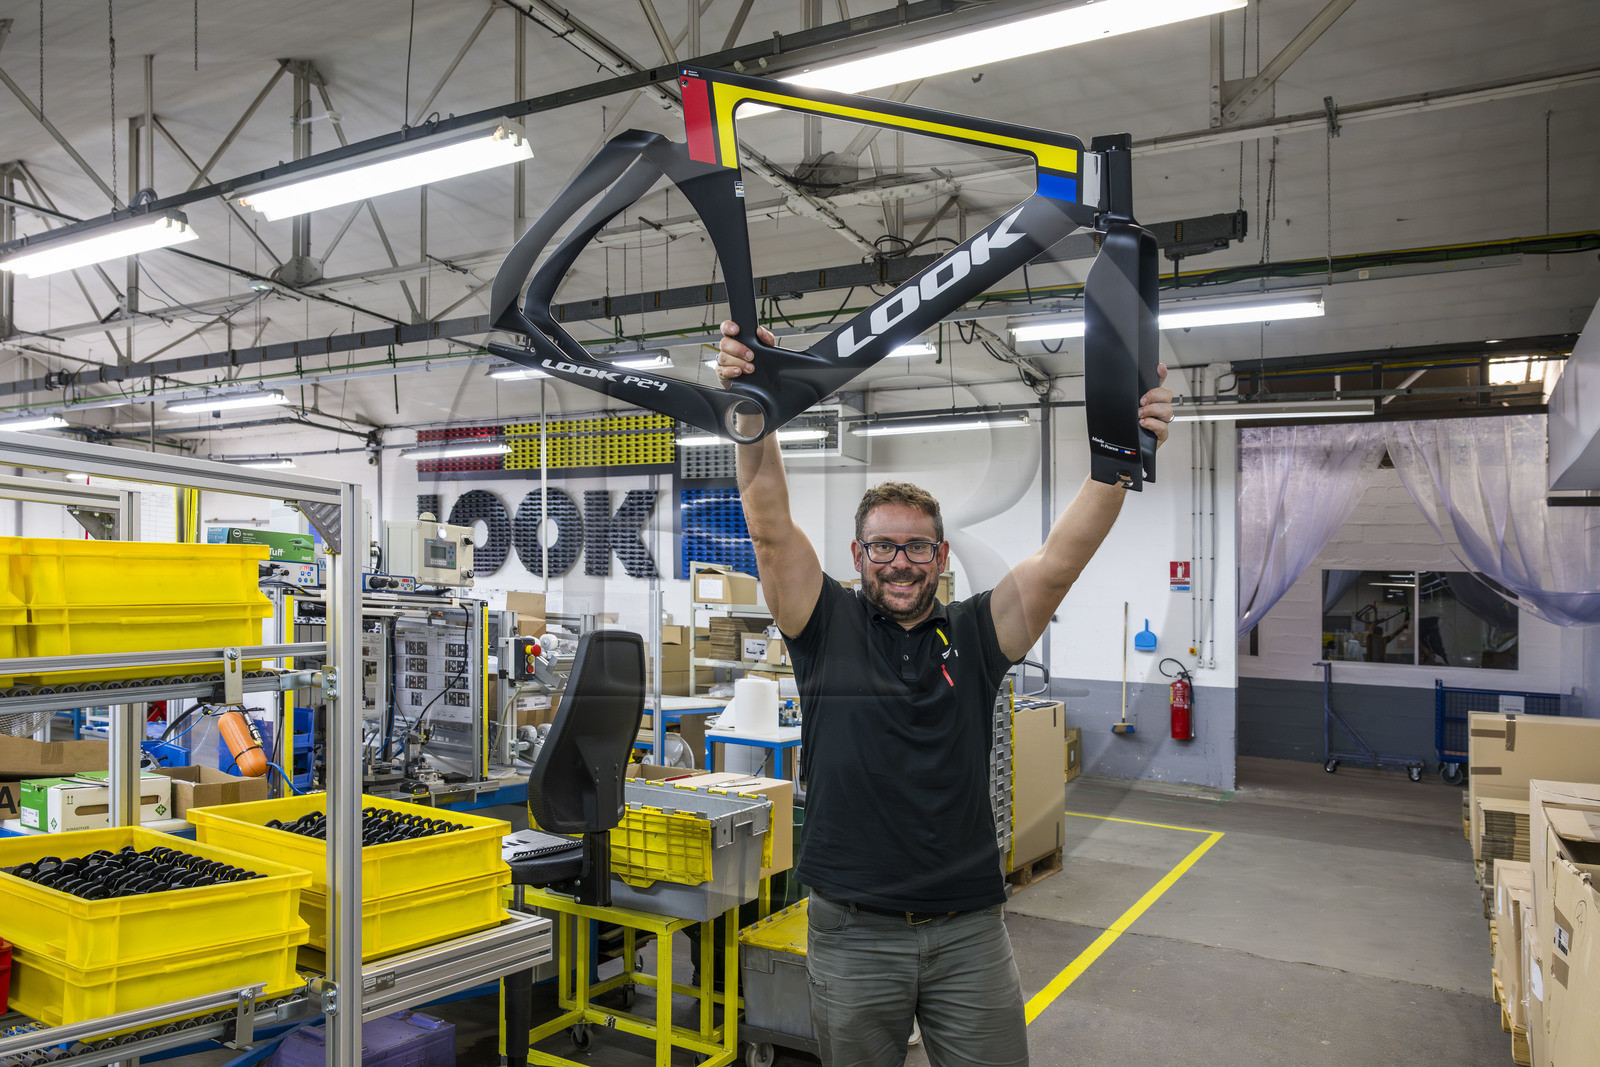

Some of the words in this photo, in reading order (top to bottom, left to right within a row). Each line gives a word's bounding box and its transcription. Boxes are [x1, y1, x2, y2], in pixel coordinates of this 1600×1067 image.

[836, 205, 1027, 358] LOOK
[541, 358, 621, 382] LOOK
[623, 375, 668, 392] P24
[1105, 444, 1119, 452] France
[416, 486, 659, 579] OOK
